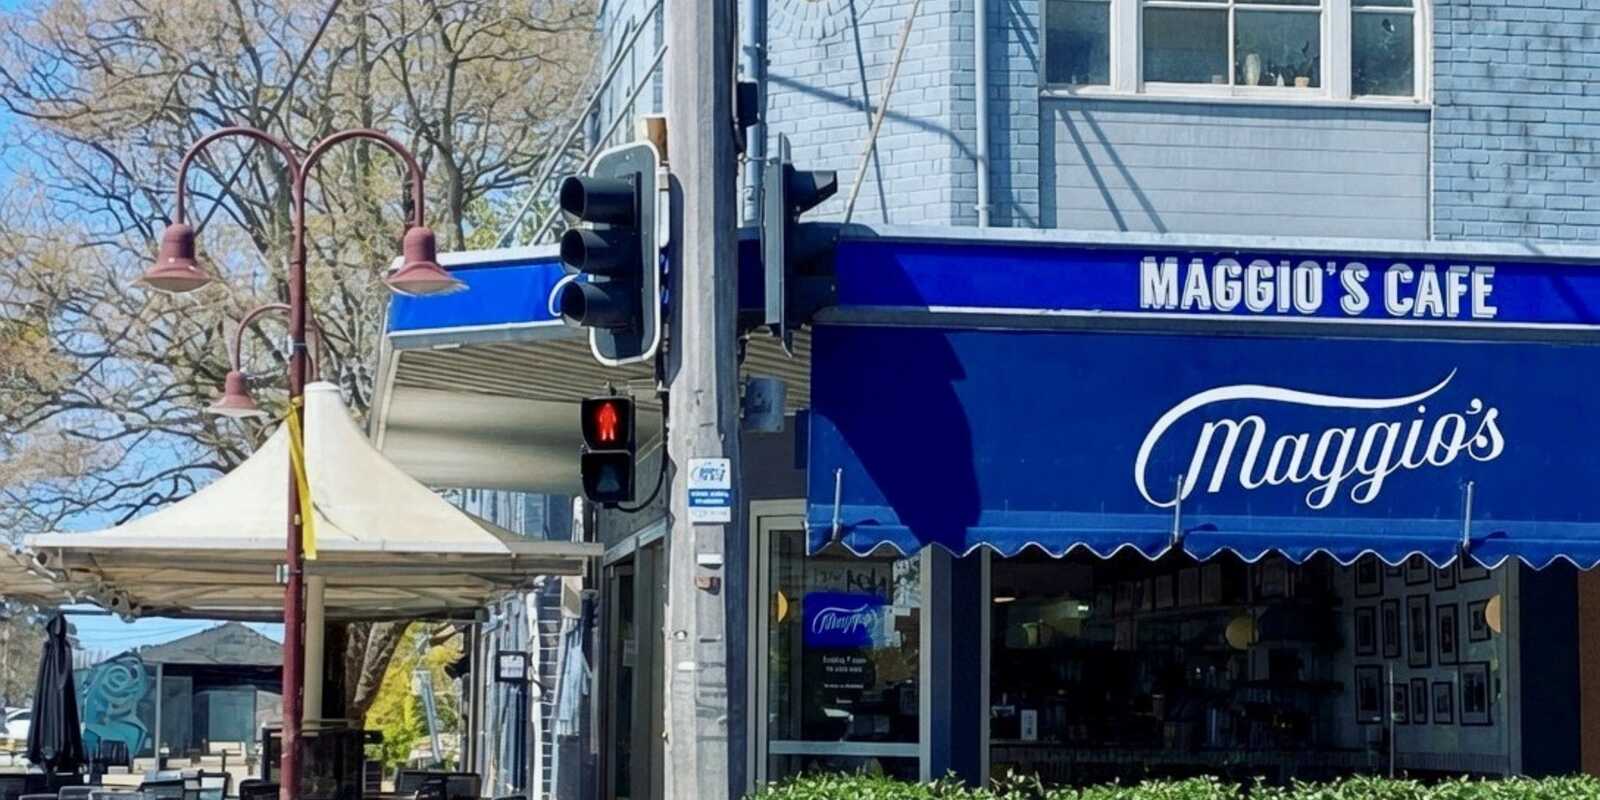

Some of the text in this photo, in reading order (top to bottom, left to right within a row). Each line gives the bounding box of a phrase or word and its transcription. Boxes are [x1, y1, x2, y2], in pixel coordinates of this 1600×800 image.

[1140, 256, 1498, 318] MAGGIO'S CAFE
[1134, 367, 1505, 510] Maggio's
